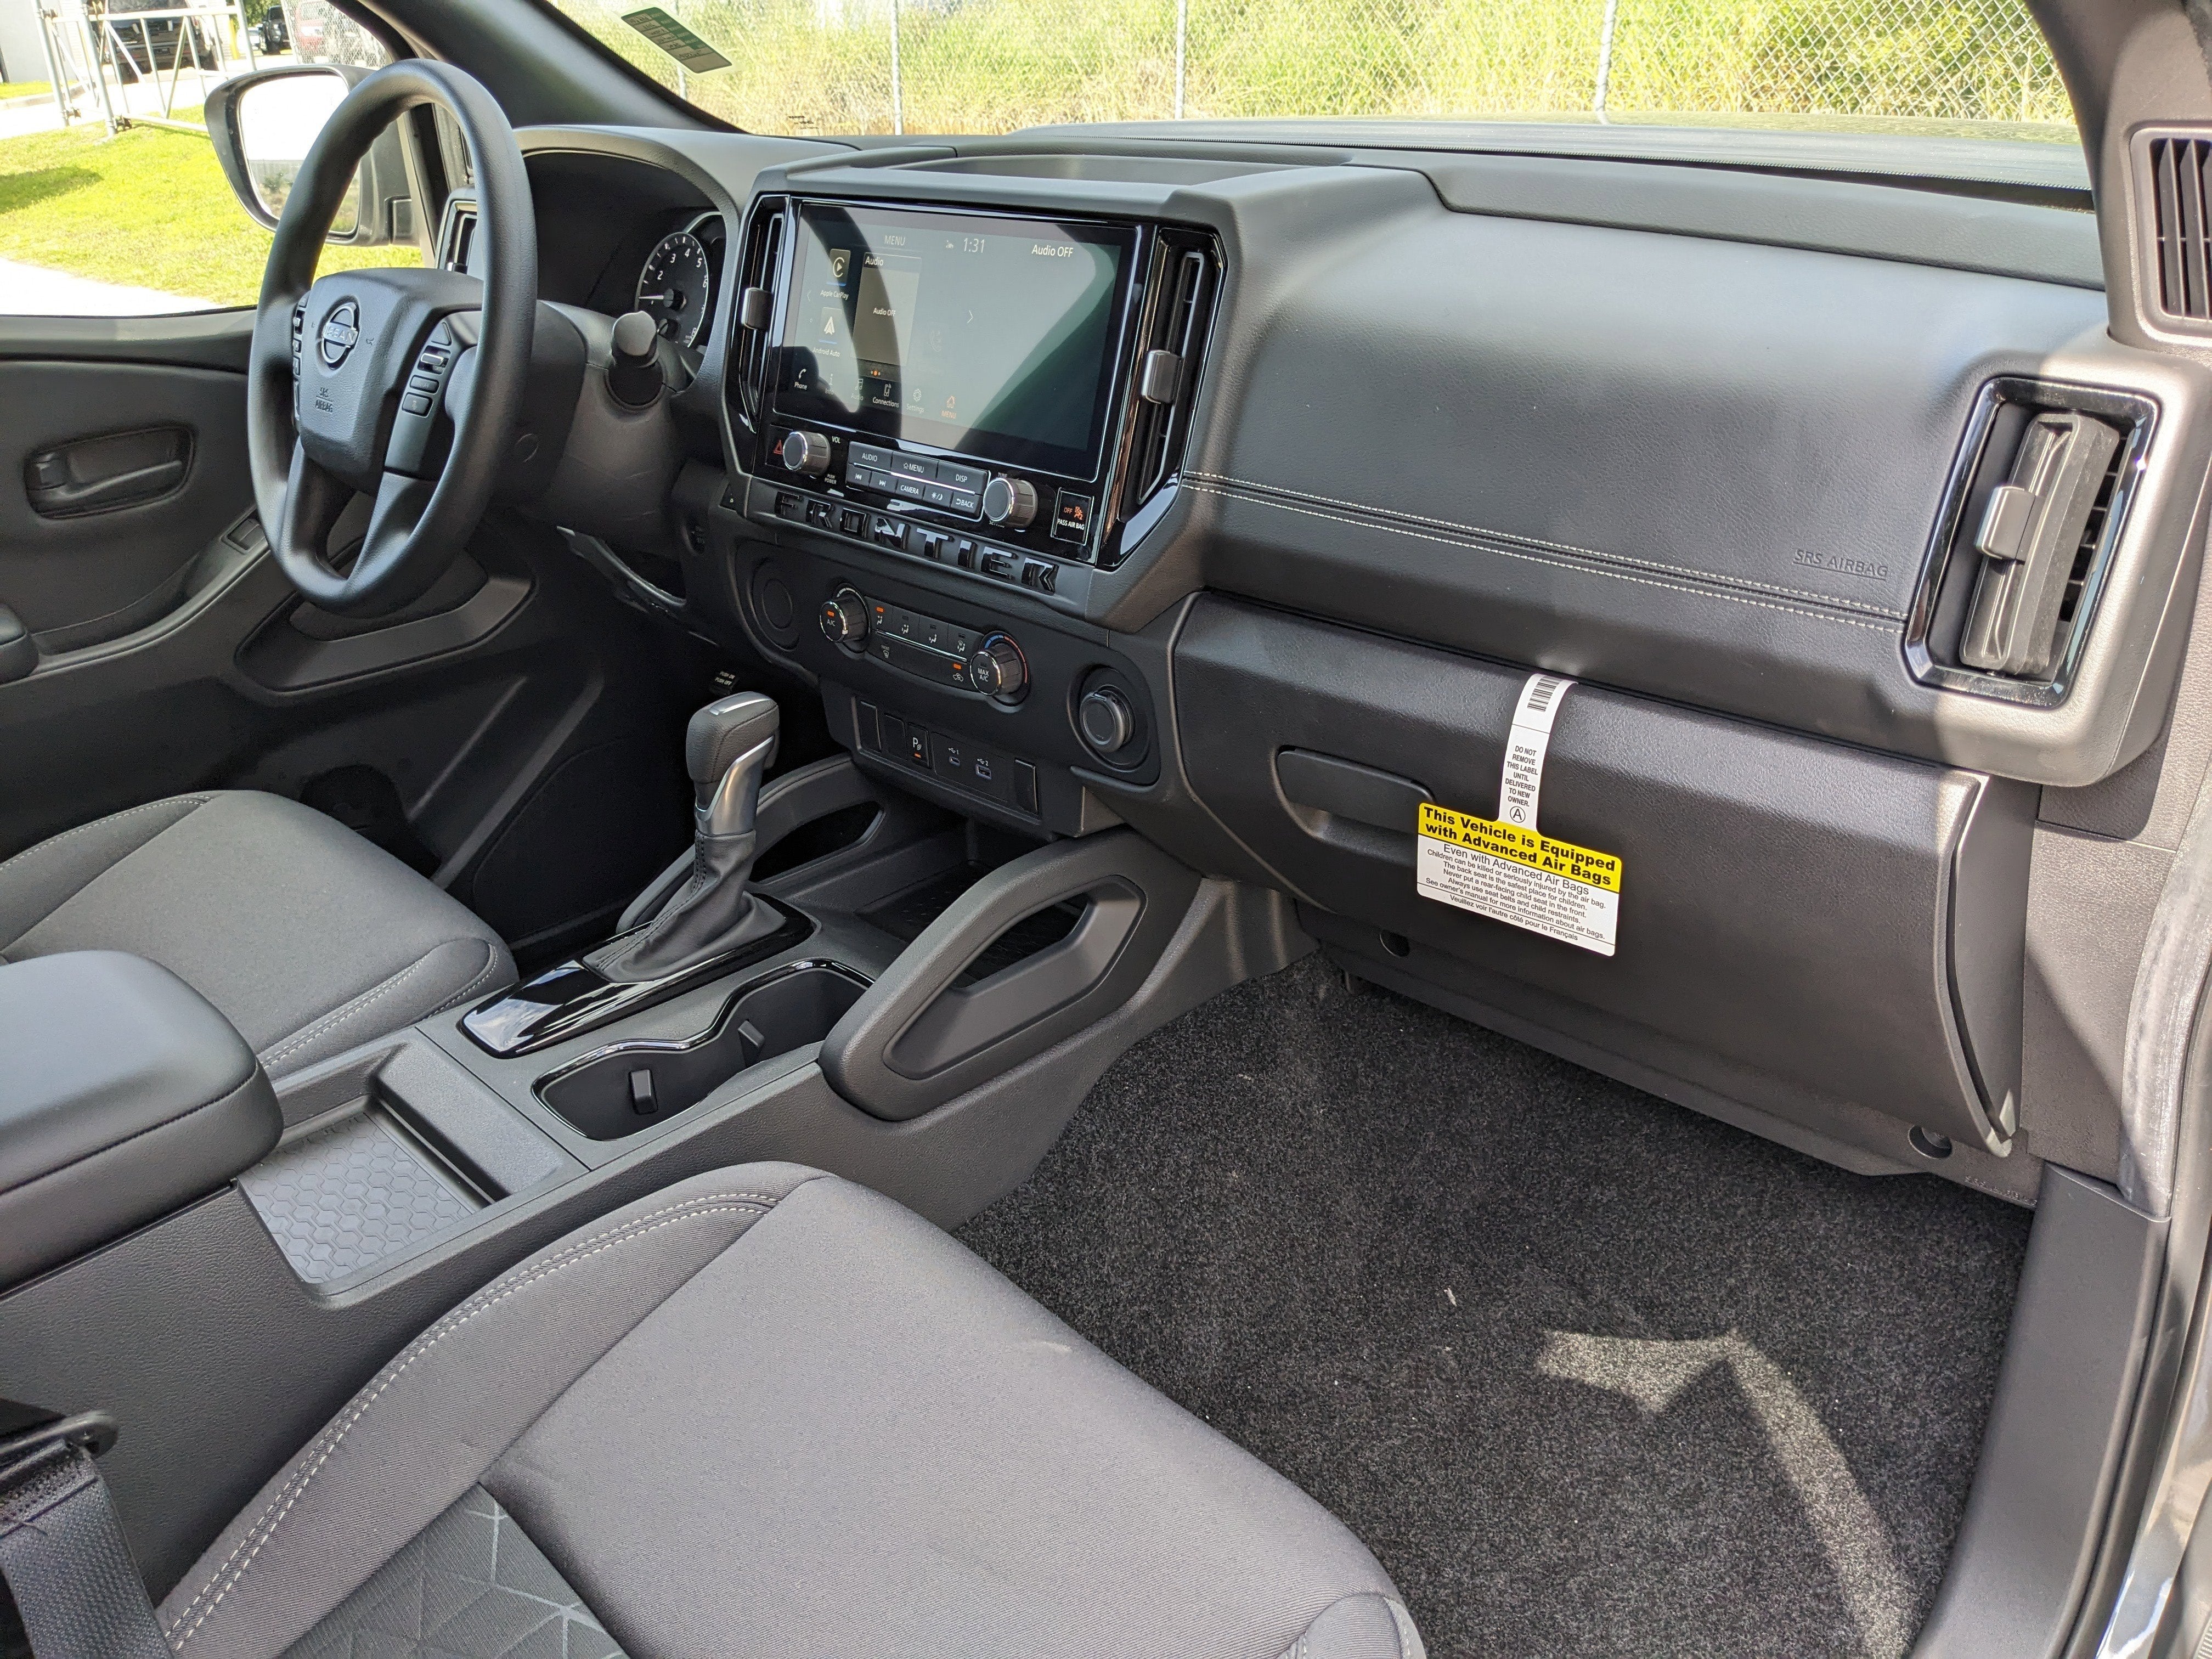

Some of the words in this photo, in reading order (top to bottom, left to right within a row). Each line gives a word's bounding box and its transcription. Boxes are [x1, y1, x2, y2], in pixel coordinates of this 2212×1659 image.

[884, 235, 906, 246] MENU
[963, 238, 985, 253] 1:31
[685, 248, 690, 258] 4
[1031, 244, 1055, 256] Audio
[1057, 246, 1074, 257] OFF
[670, 253, 676, 263] 3
[696, 258, 703, 268] 5
[865, 256, 884, 267] Audio
[657, 270, 663, 280] 2
[833, 291, 849, 301] CarPlay
[872, 397, 899, 408] Connections
[906, 403, 925, 414] Settings
[941, 410, 956, 419] MENU
[861, 453, 878, 462] AUDIO
[909, 463, 924, 473] MENU
[955, 474, 968, 483] DISP
[900, 485, 919, 495] CAMERA
[961, 499, 974, 509] BACK
[774, 492, 1059, 595] FRONTIER
[1795, 549, 1823, 565] SRS
[1827, 556, 1888, 577] AIRBAG
[978, 668, 989, 676] MAX
[1524, 748, 1537, 757] NOT
[1512, 754, 1536, 765] REMOVE
[1507, 761, 1519, 770] THIS
[1520, 765, 1538, 775] LABEL
[1513, 772, 1529, 781] UNTIL
[1505, 778, 1536, 792] DELIVERED
[1517, 790, 1530, 798] NEW
[1508, 796, 1530, 806] OWNER.
[1424, 806, 1455, 825] This
[1460, 817, 1516, 842] Vehicle
[1521, 835, 1534, 848] is
[1540, 840, 1615, 871] Equipped
[1425, 823, 1457, 840] with
[1462, 832, 1537, 863] Advanced
[1542, 856, 1566, 871] Air
[1571, 864, 1611, 885] Bags
[1443, 844, 1468, 859] Even
[1471, 854, 1490, 865] with
[1492, 859, 1542, 881] Advanced
[1544, 874, 1559, 885] Air
[1562, 879, 1589, 895] Bags
[1427, 849, 1453, 861] Children
[1477, 864, 1493, 873] killed
[1504, 873, 1532, 886] seriously
[1534, 881, 1556, 893] injured
[1558, 888, 1566, 897] by
[1568, 891, 1578, 900] the
[1591, 898, 1606, 909] bag.
[1443, 861, 1455, 870] The
[1457, 865, 1472, 874] back
[1474, 871, 1487, 879] seat
[1508, 882, 1527, 891] safest
[1528, 888, 1546, 898] place
[1559, 898, 1587, 911] children.
[1443, 868, 1462, 878] Never
[1481, 881, 1514, 896] rear-facing
[1516, 891, 1532, 900] child
[1533, 897, 1548, 906] seat
[1570, 907, 1587, 918] front.
[1448, 878, 1470, 889] Always
[1485, 889, 1498, 898] seat
[1500, 893, 1515, 903] belts
[1531, 904, 1546, 912] child
[1548, 909, 1581, 923] restraints.
[1426, 878, 1438, 886] See
[1440, 883, 1464, 894] owner's
[1465, 890, 1488, 902] manual
[1500, 901, 1516, 910] more
[1517, 906, 1554, 922] information
[1555, 919, 1575, 929] about
[1587, 928, 1605, 939] bags.
[1450, 894, 1474, 907] Veuillez
[1476, 902, 1487, 911] voir
[1488, 907, 1508, 918] l'autre
[1510, 915, 1523, 923] côté
[1525, 919, 1540, 928] pour
[1550, 926, 1578, 940] Français
